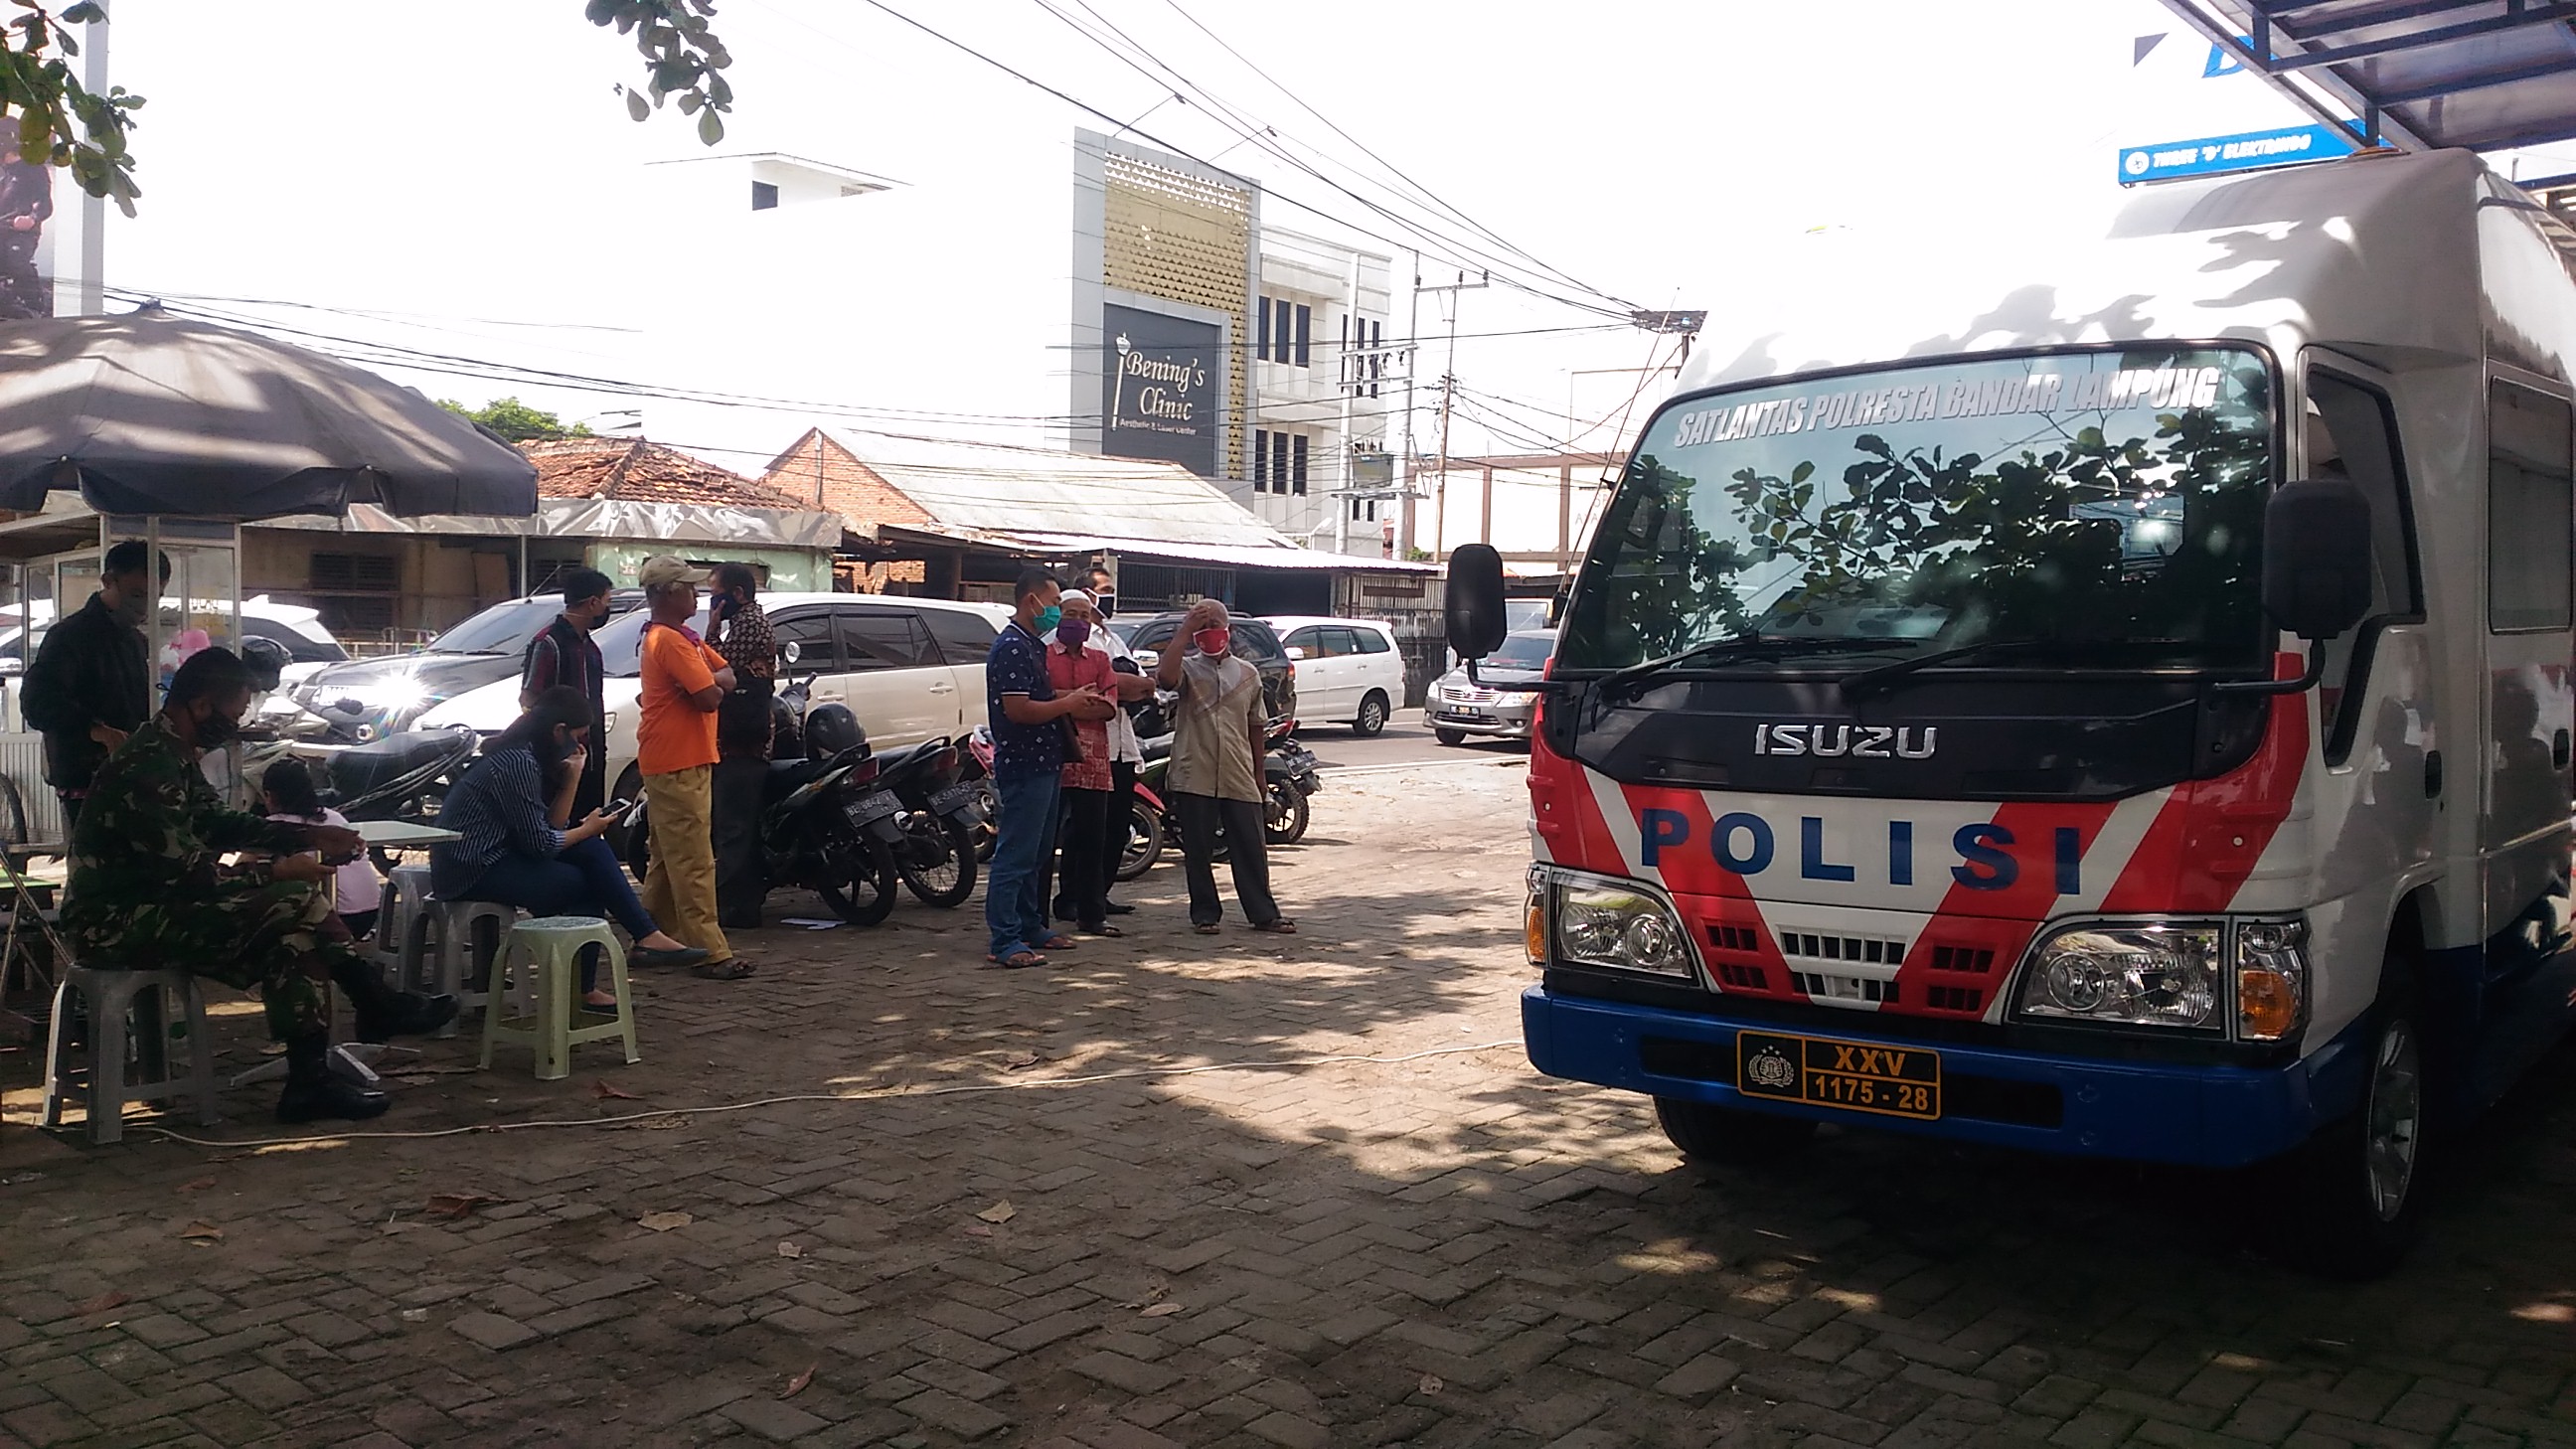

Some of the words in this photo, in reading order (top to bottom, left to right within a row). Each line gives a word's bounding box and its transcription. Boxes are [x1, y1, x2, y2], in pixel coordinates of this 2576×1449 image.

[1126, 351, 1206, 393] Bening's
[1140, 387, 1193, 421] Clinic
[1674, 397, 1809, 448] SATLANTAS
[1806, 384, 1940, 431] POLRESTA
[1941, 374, 2063, 419] BANDAR
[2065, 367, 2219, 412] LAMPUNG
[1754, 724, 1939, 759] ISUZU
[1641, 808, 2081, 895] POLISI
[1835, 1046, 1906, 1076] XXV
[1815, 1074, 1874, 1104] 1175
[1898, 1085, 1929, 1111] 28
